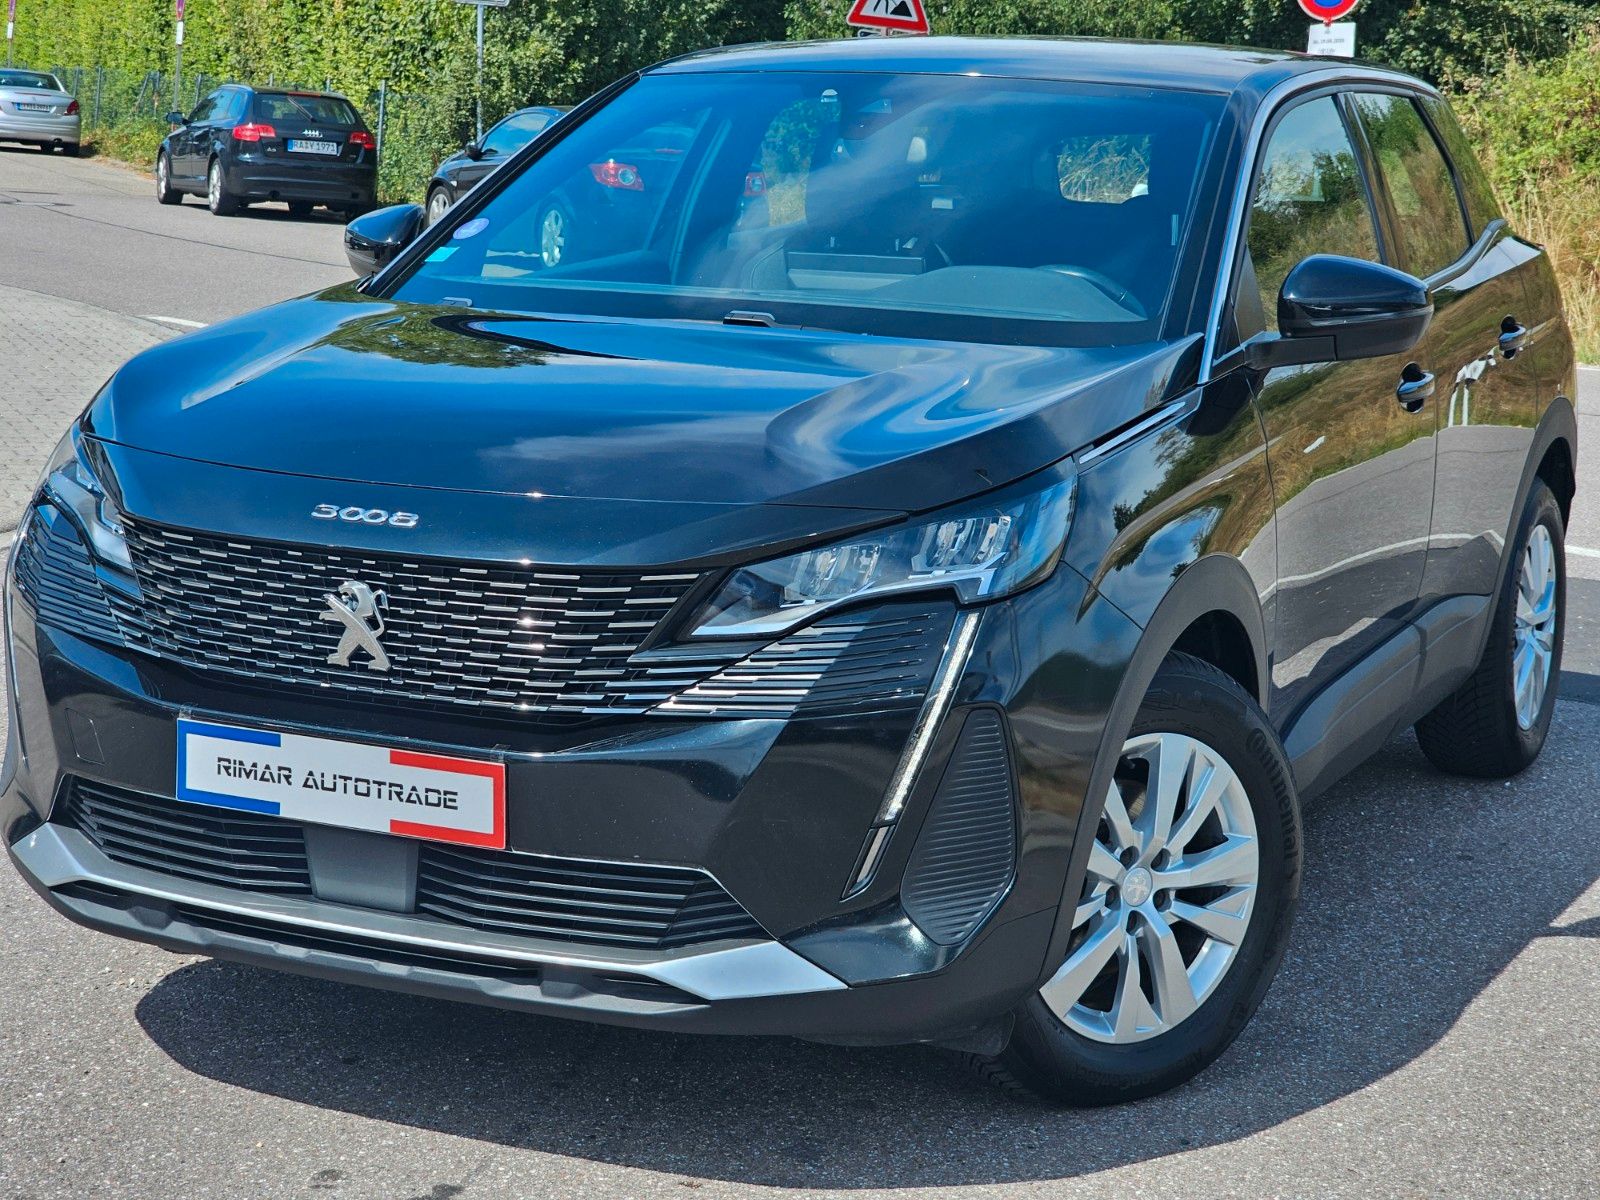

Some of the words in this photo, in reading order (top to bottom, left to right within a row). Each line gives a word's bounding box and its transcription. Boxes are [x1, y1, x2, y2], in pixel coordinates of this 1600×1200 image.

[316, 142, 336, 152] 1971
[311, 503, 420, 528] 3008
[216, 756, 292, 787] RIMAR
[302, 770, 459, 811] AUTOTRADE
